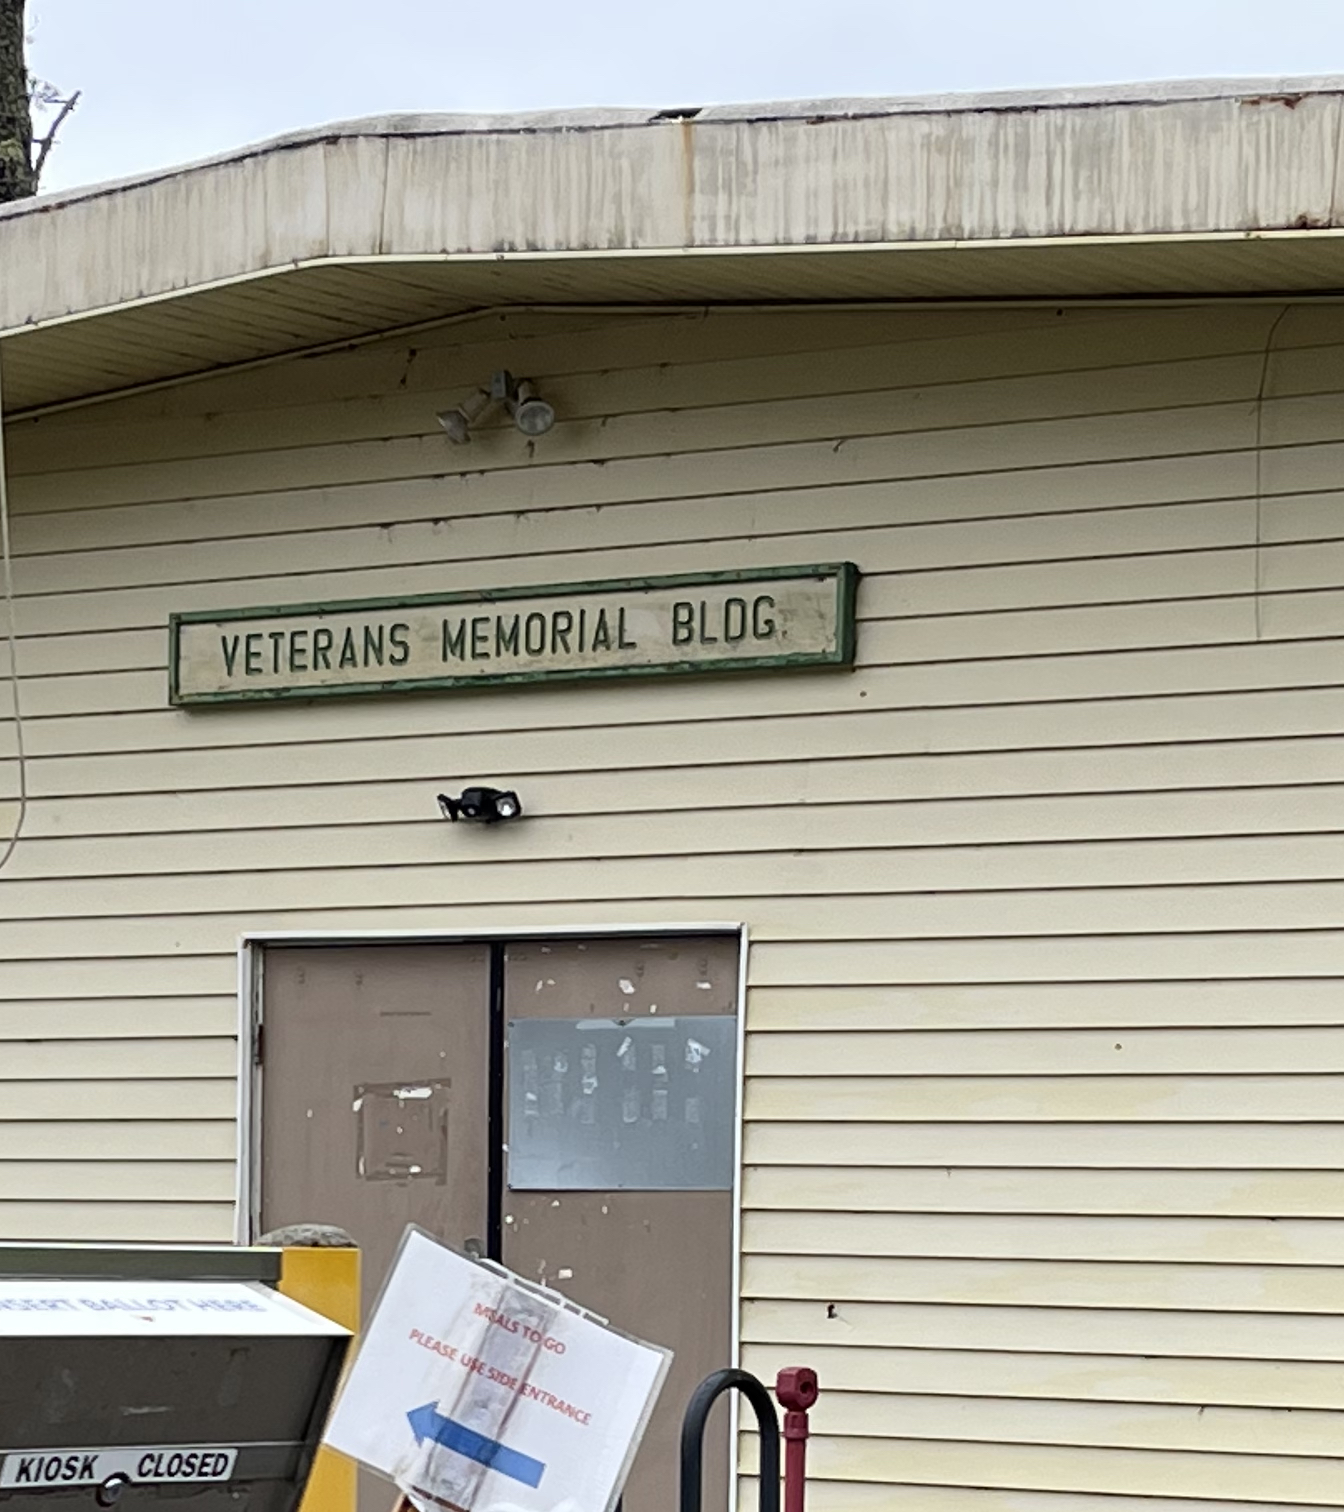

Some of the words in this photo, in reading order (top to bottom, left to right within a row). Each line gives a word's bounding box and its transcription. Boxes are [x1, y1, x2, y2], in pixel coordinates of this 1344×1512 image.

[220, 623, 411, 678] VETERANS
[441, 607, 637, 663] MEMORIAL
[77, 1297, 191, 1312] BALLOT
[522, 1325, 543, 1343] TO
[543, 1337, 566, 1355] GO
[408, 1328, 459, 1361] PLEASE
[460, 1353, 486, 1376] USE
[487, 1366, 518, 1391] SIDE
[520, 1382, 592, 1426] ENTRANCE
[15, 1453, 99, 1483] KIOSK
[137, 1452, 229, 1480] CLOSED
